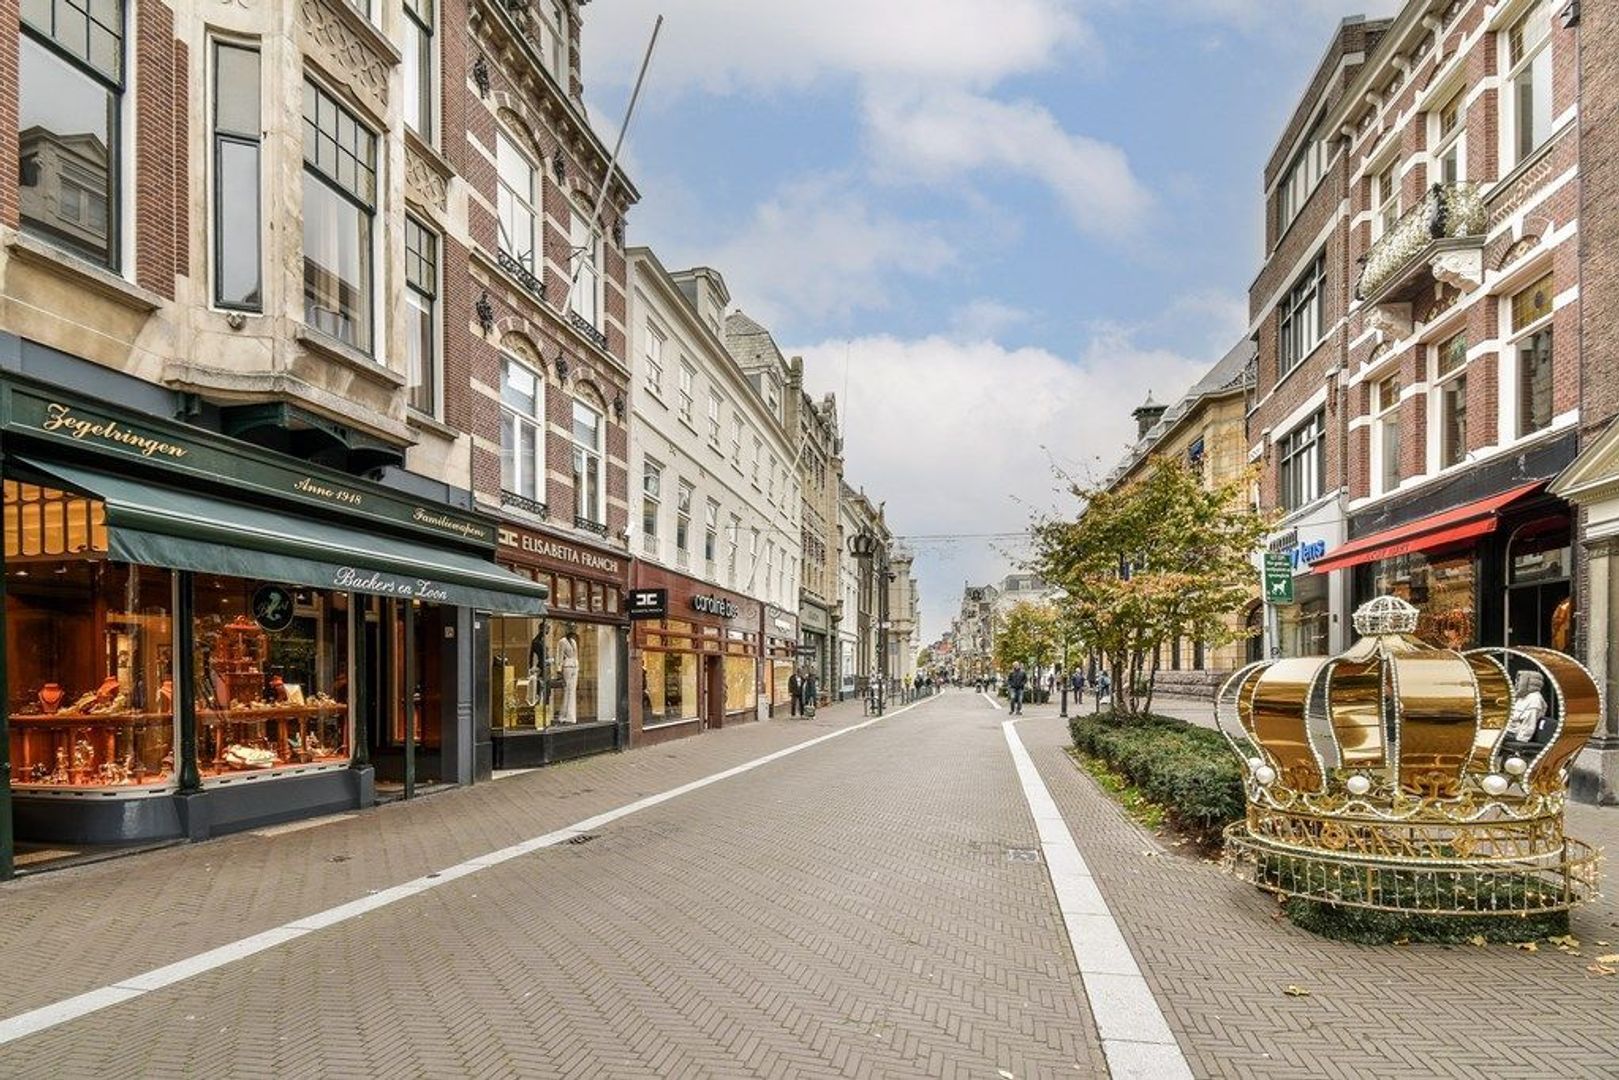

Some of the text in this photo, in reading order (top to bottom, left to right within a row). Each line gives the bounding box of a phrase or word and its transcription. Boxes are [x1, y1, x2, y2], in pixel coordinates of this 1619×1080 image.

[43, 403, 188, 457] Zegelringen
[294, 477, 334, 498] Anno
[412, 507, 486, 538] Familiewapens
[521, 534, 619, 573] ELISABETTA FRANCHI
[333, 566, 448, 600] Backers en Zoon
